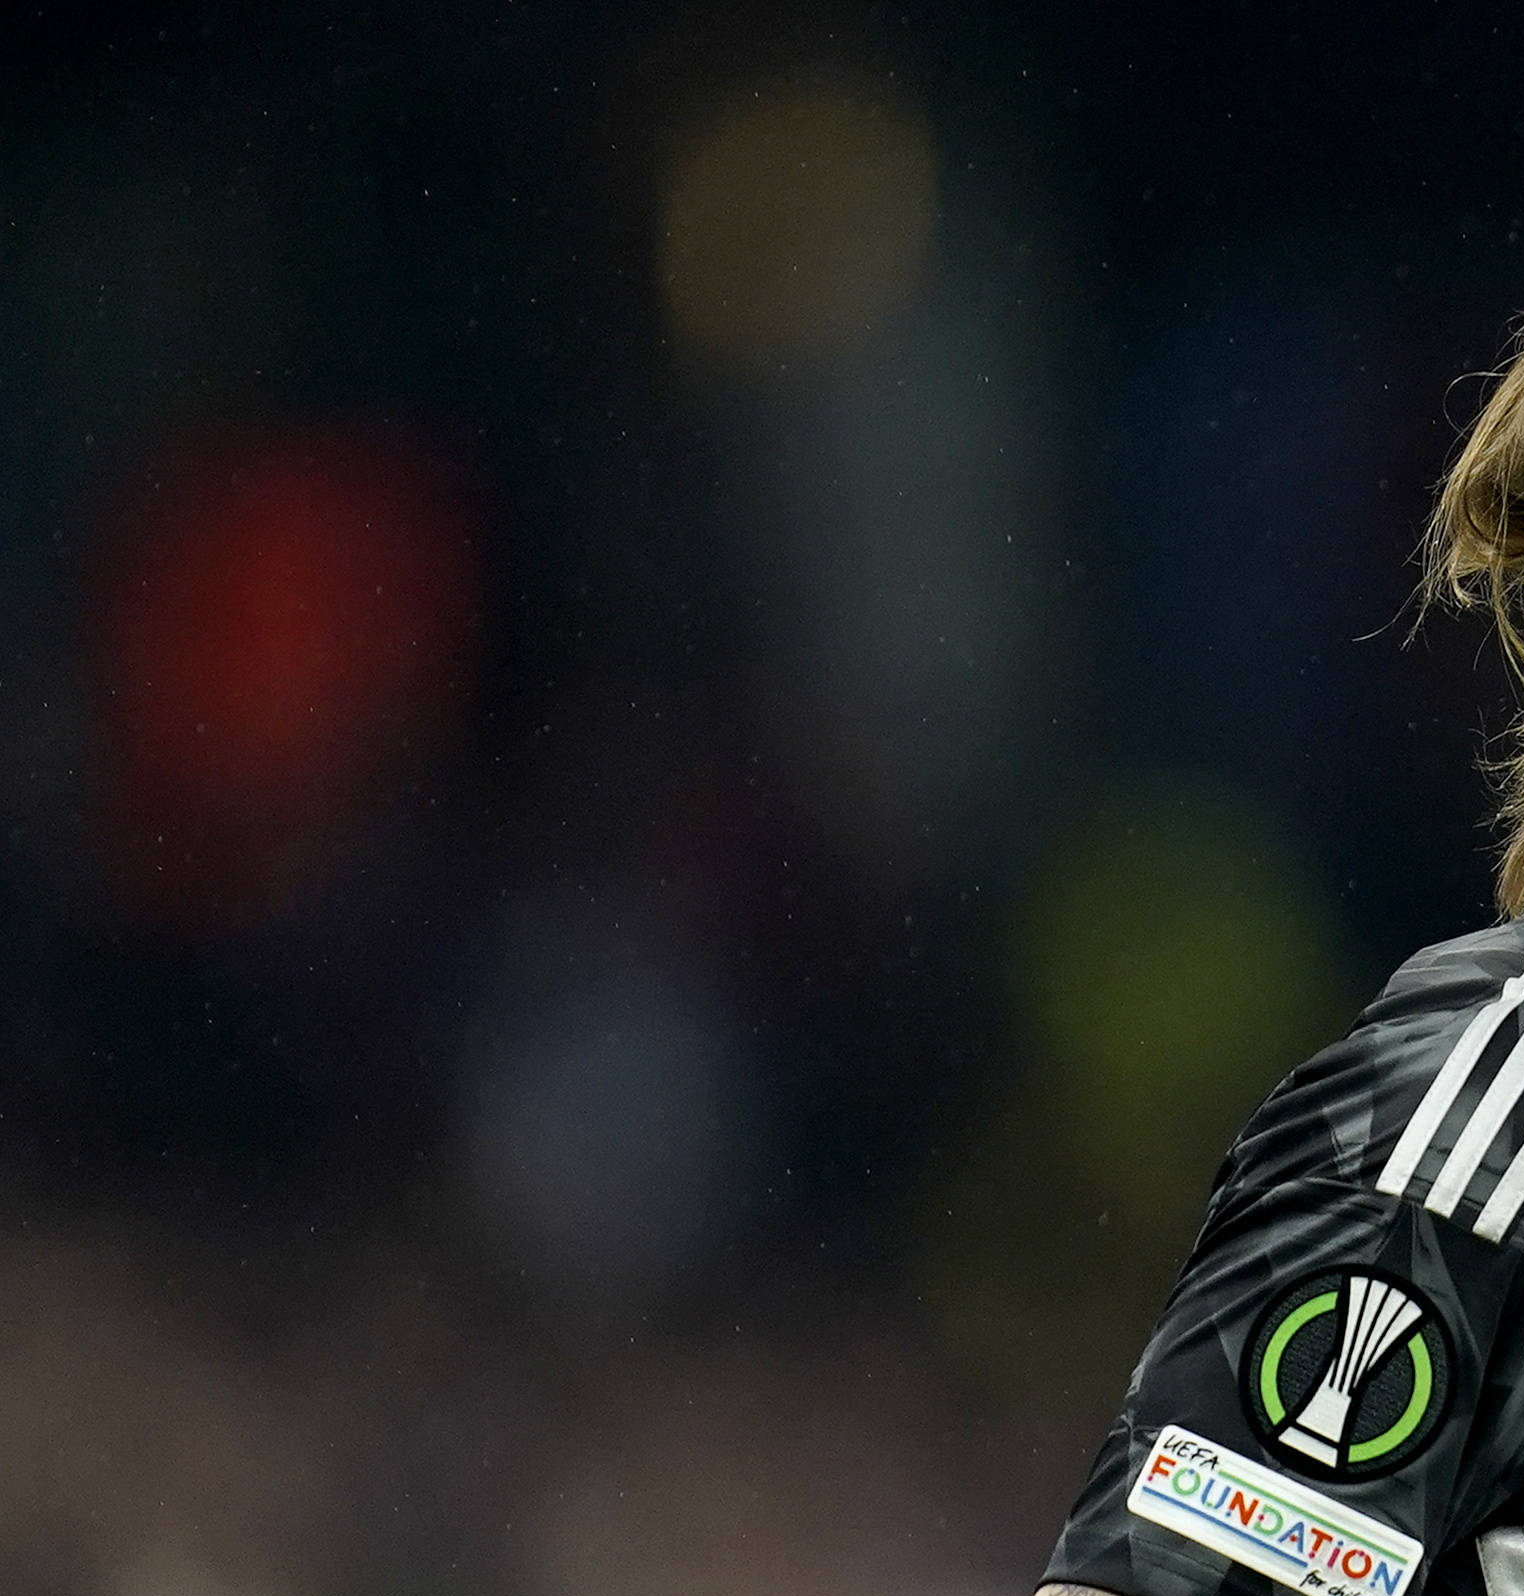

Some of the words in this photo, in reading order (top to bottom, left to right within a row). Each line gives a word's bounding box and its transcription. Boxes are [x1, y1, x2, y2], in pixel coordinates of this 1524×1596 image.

[1163, 1434, 1220, 1471] UEFA
[1147, 1455, 1404, 1596] FOUNDATION
[1300, 1569, 1326, 1588] for
